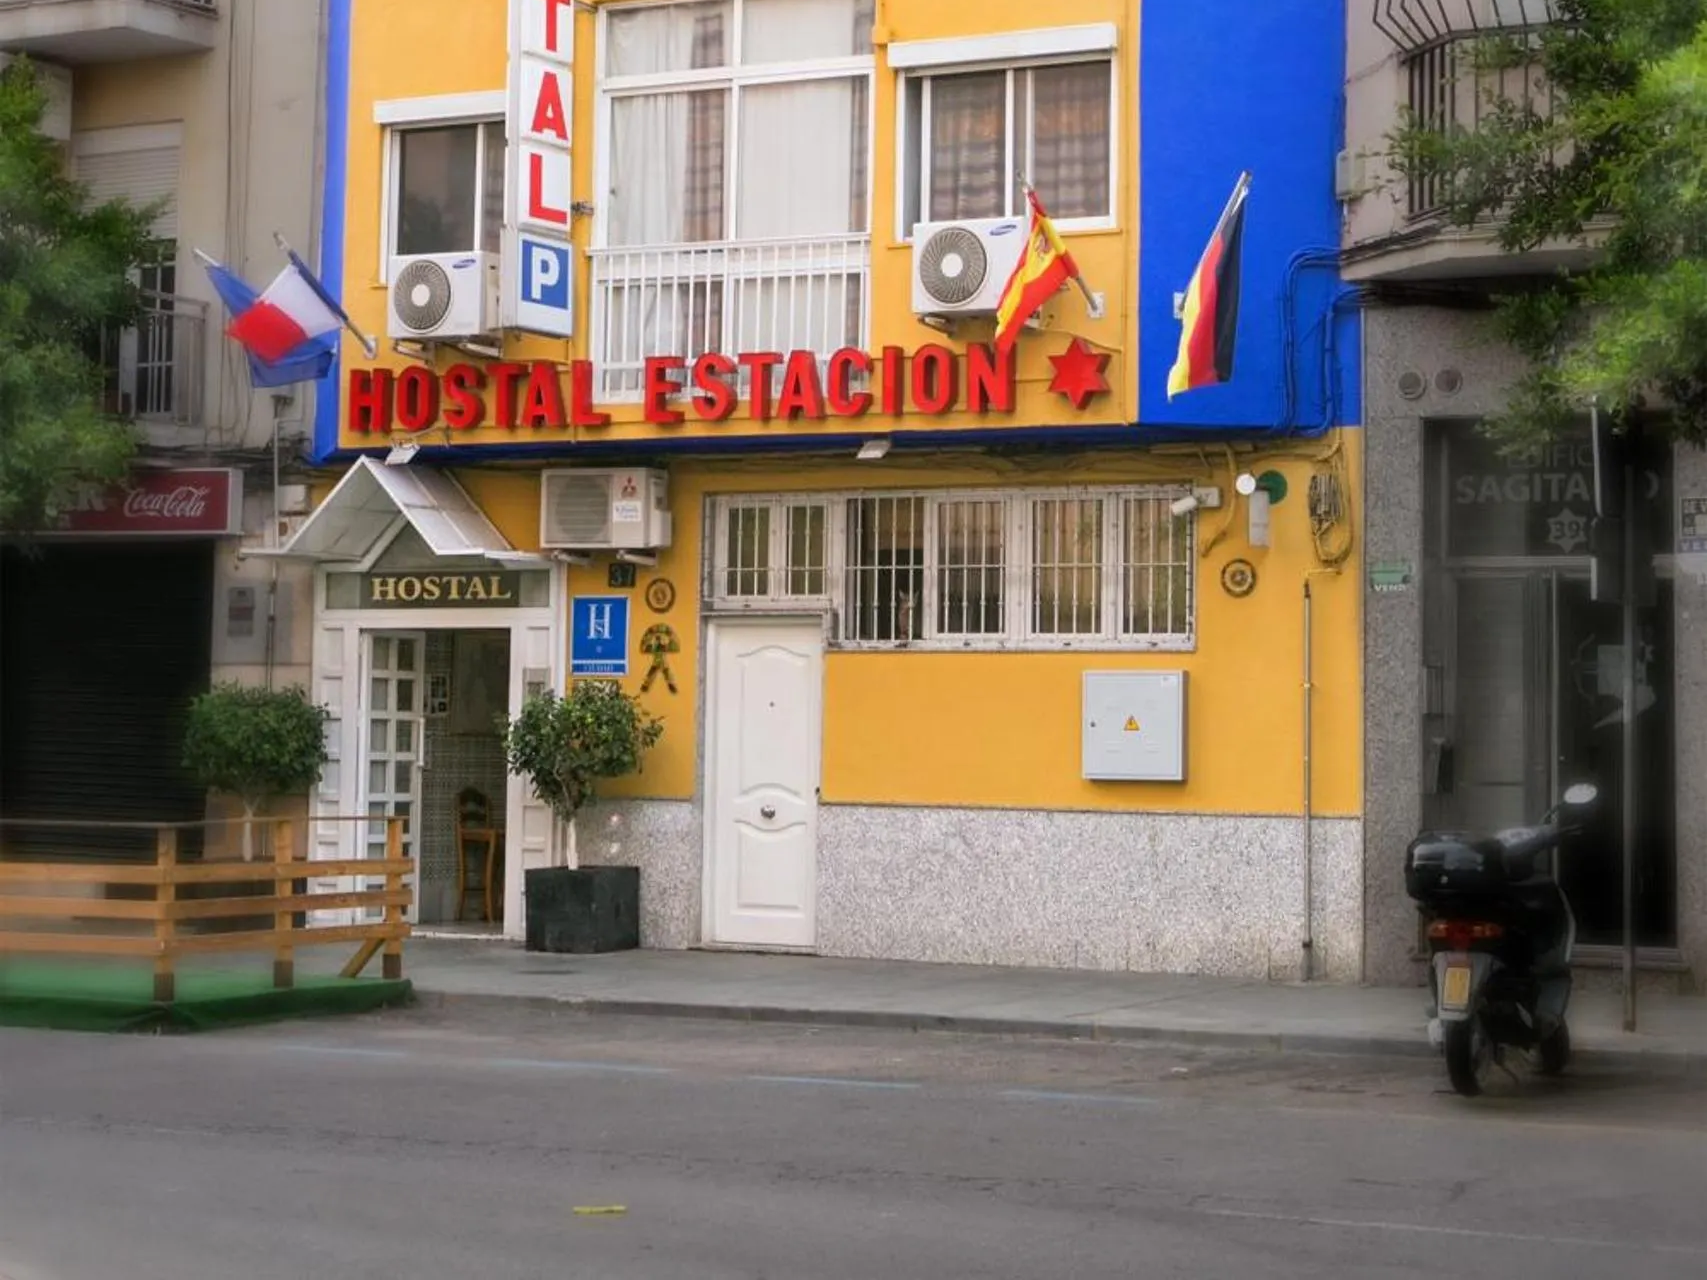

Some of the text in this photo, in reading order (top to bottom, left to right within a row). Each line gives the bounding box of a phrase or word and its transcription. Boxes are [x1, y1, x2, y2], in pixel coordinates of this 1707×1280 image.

[531, 246, 559, 301] P
[348, 342, 1018, 434] HOSTAL ESTACION
[371, 576, 512, 601] HOSTAL
